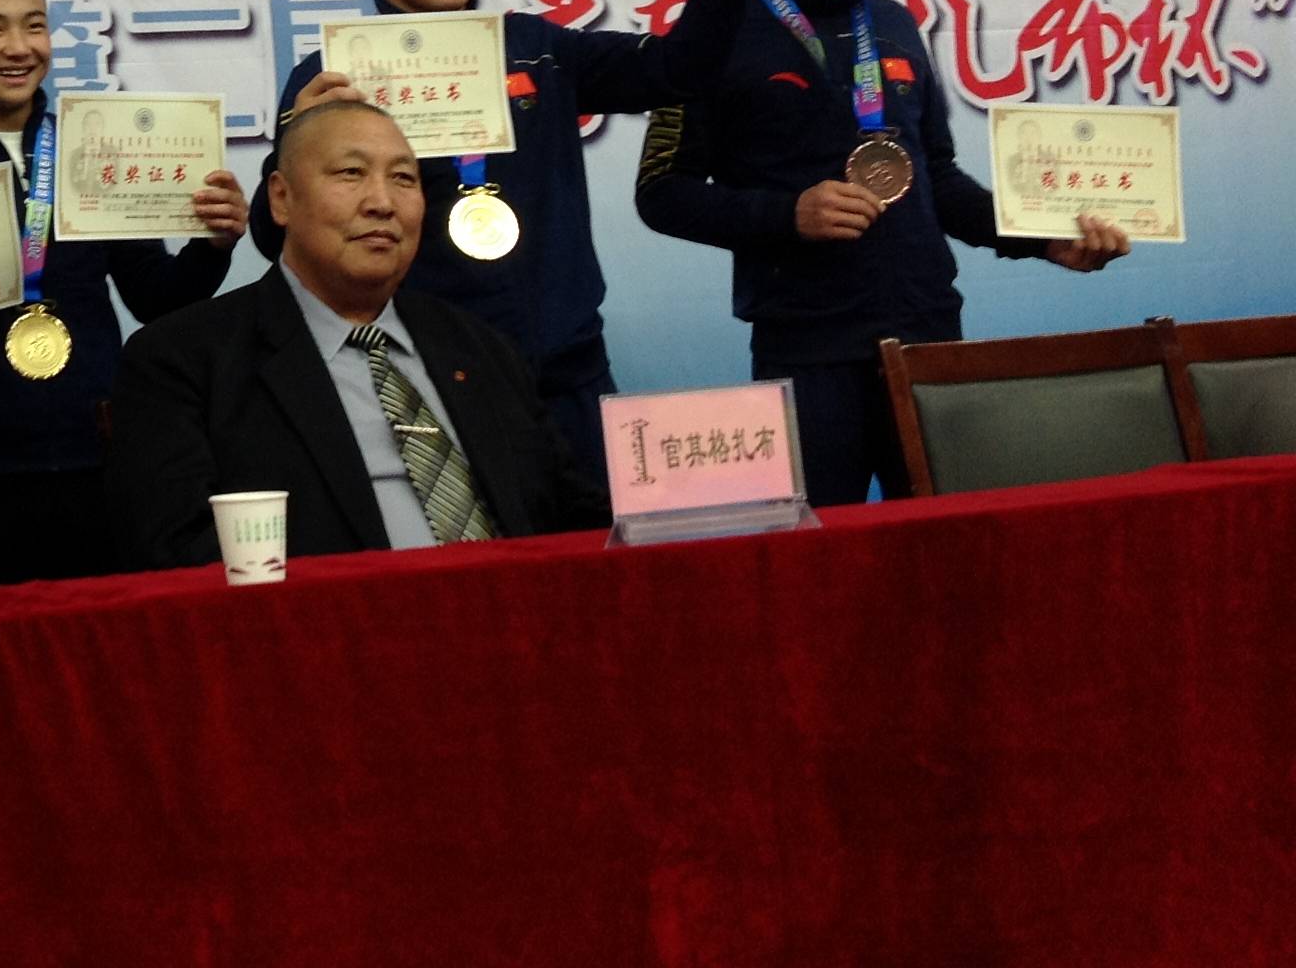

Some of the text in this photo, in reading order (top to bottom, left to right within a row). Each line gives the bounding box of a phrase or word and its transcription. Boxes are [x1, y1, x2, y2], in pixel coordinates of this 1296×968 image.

[374, 82, 462, 106] 获奖证书
[100, 164, 187, 185] 获奖证书
[1041, 170, 1134, 191] 获奖证书
[660, 426, 776, 469] 官其格扎布
